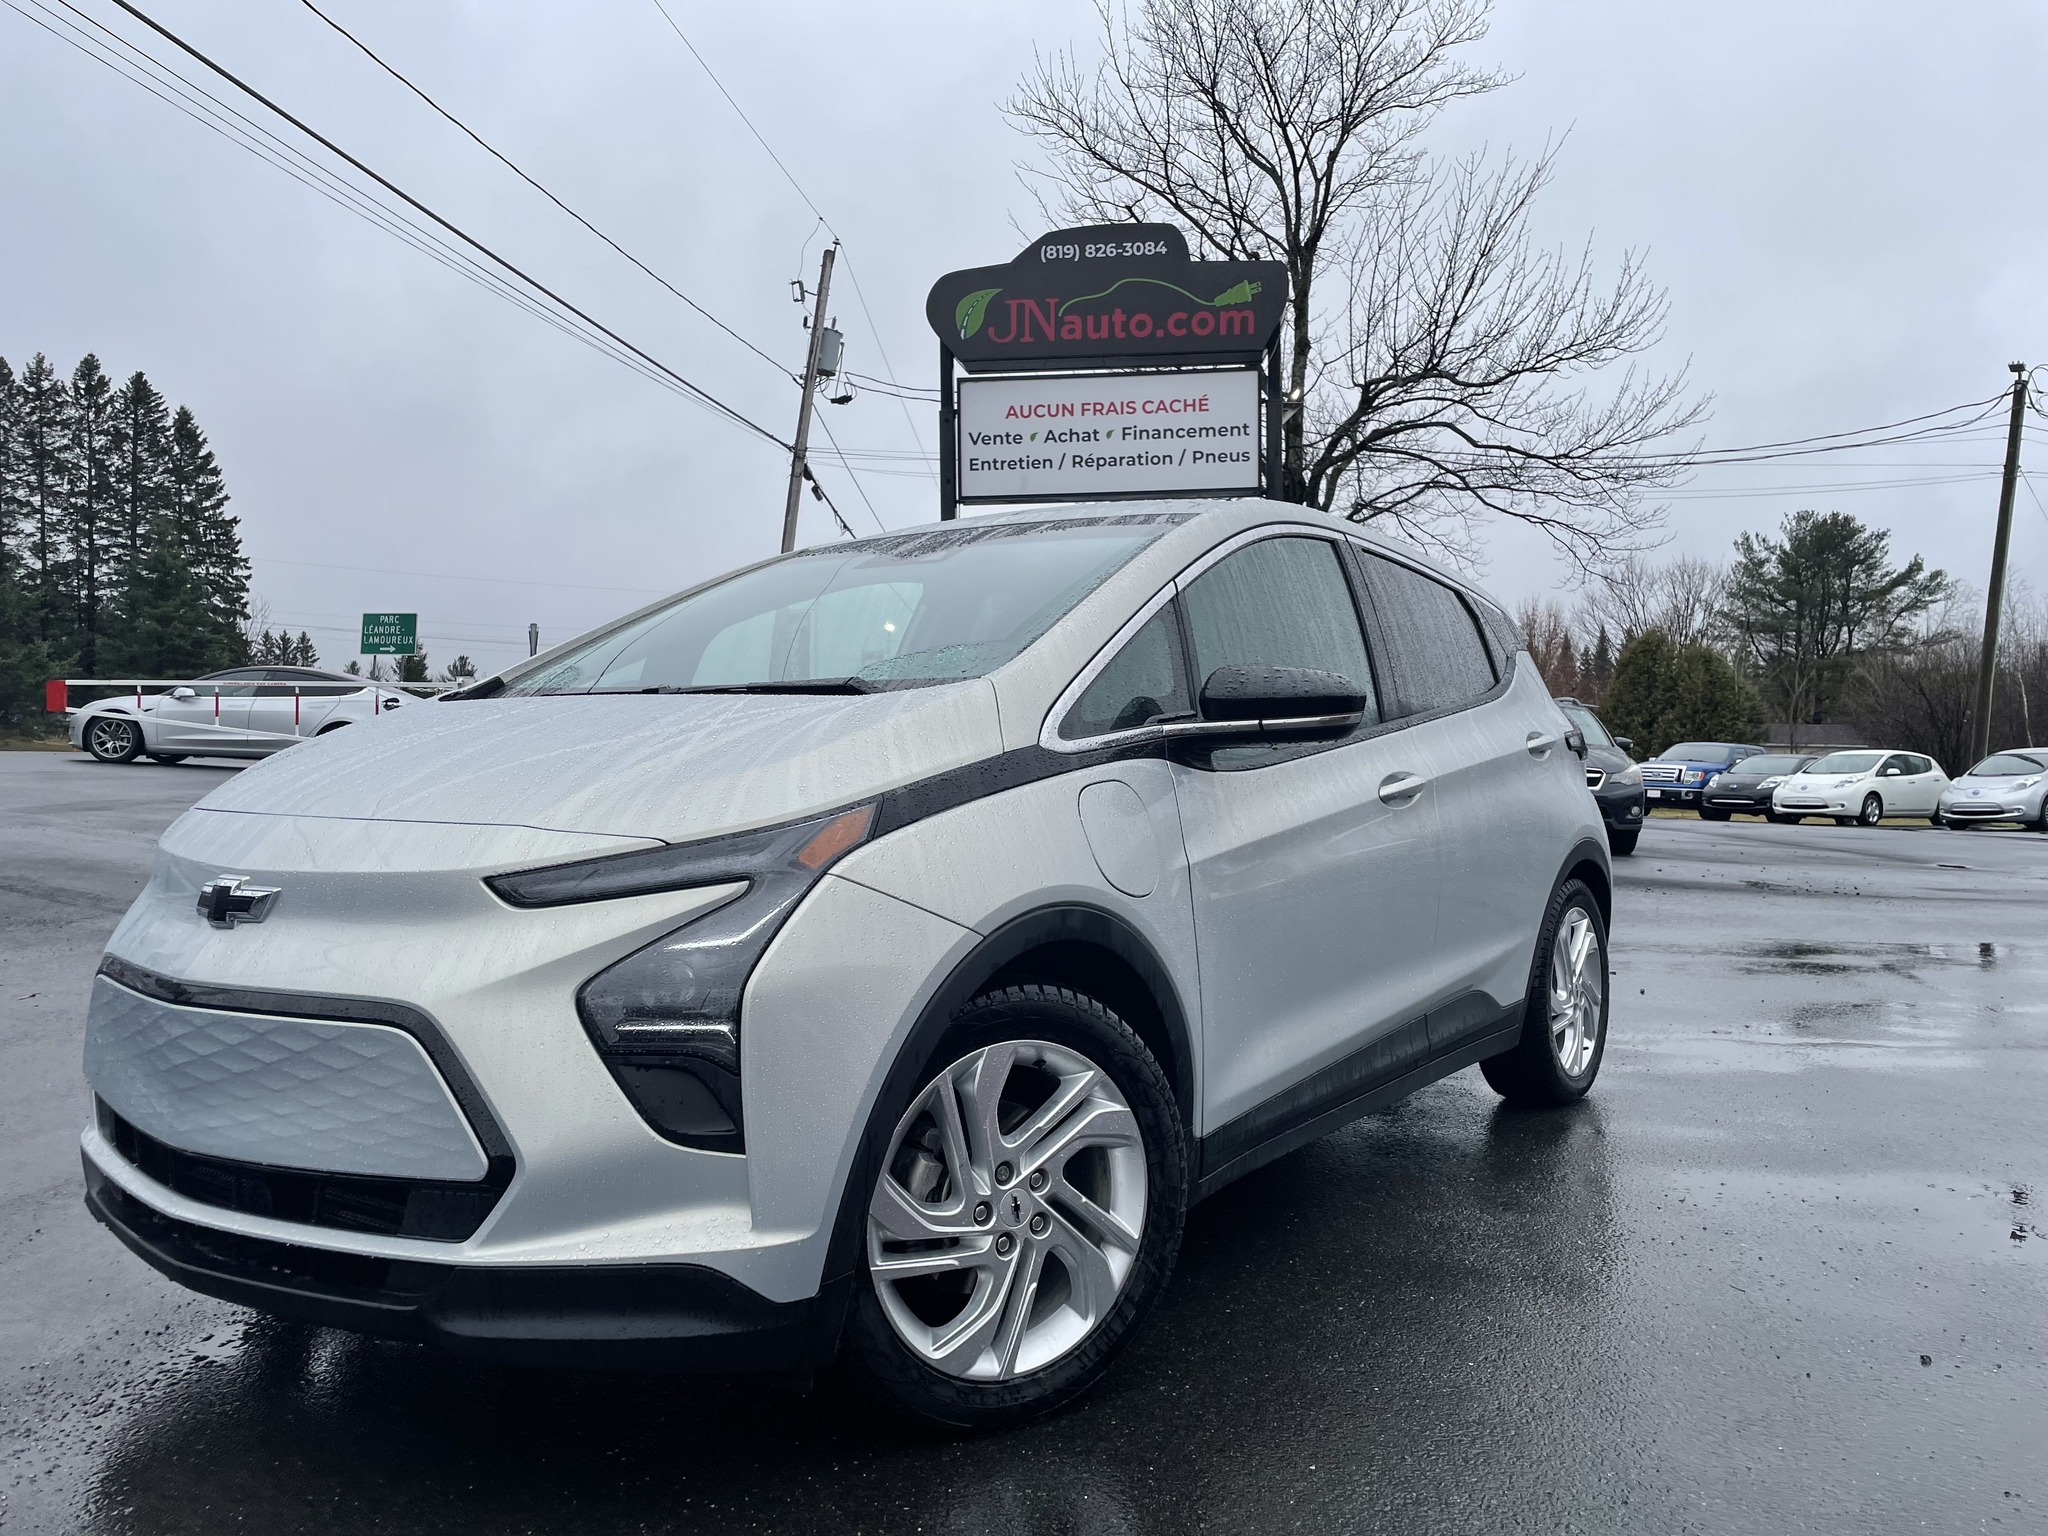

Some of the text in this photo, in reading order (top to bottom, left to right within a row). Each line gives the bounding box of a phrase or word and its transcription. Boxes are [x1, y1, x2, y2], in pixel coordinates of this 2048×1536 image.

[1040, 241, 1168, 263] (819) 826-3084
[987, 298, 1256, 344] JNauto.com
[1005, 394, 1210, 420] AUCUN FRAIS CACHÉ
[968, 423, 1250, 446] Vente Achat Financement
[969, 458, 1054, 472] Entretien
[1072, 451, 1173, 471] Réparation
[1192, 450, 1251, 464] Pneus
[364, 624, 405, 635] LÉANDRE-
[380, 615, 400, 624] PARC
[363, 635, 414, 645] LAMOUREUX
